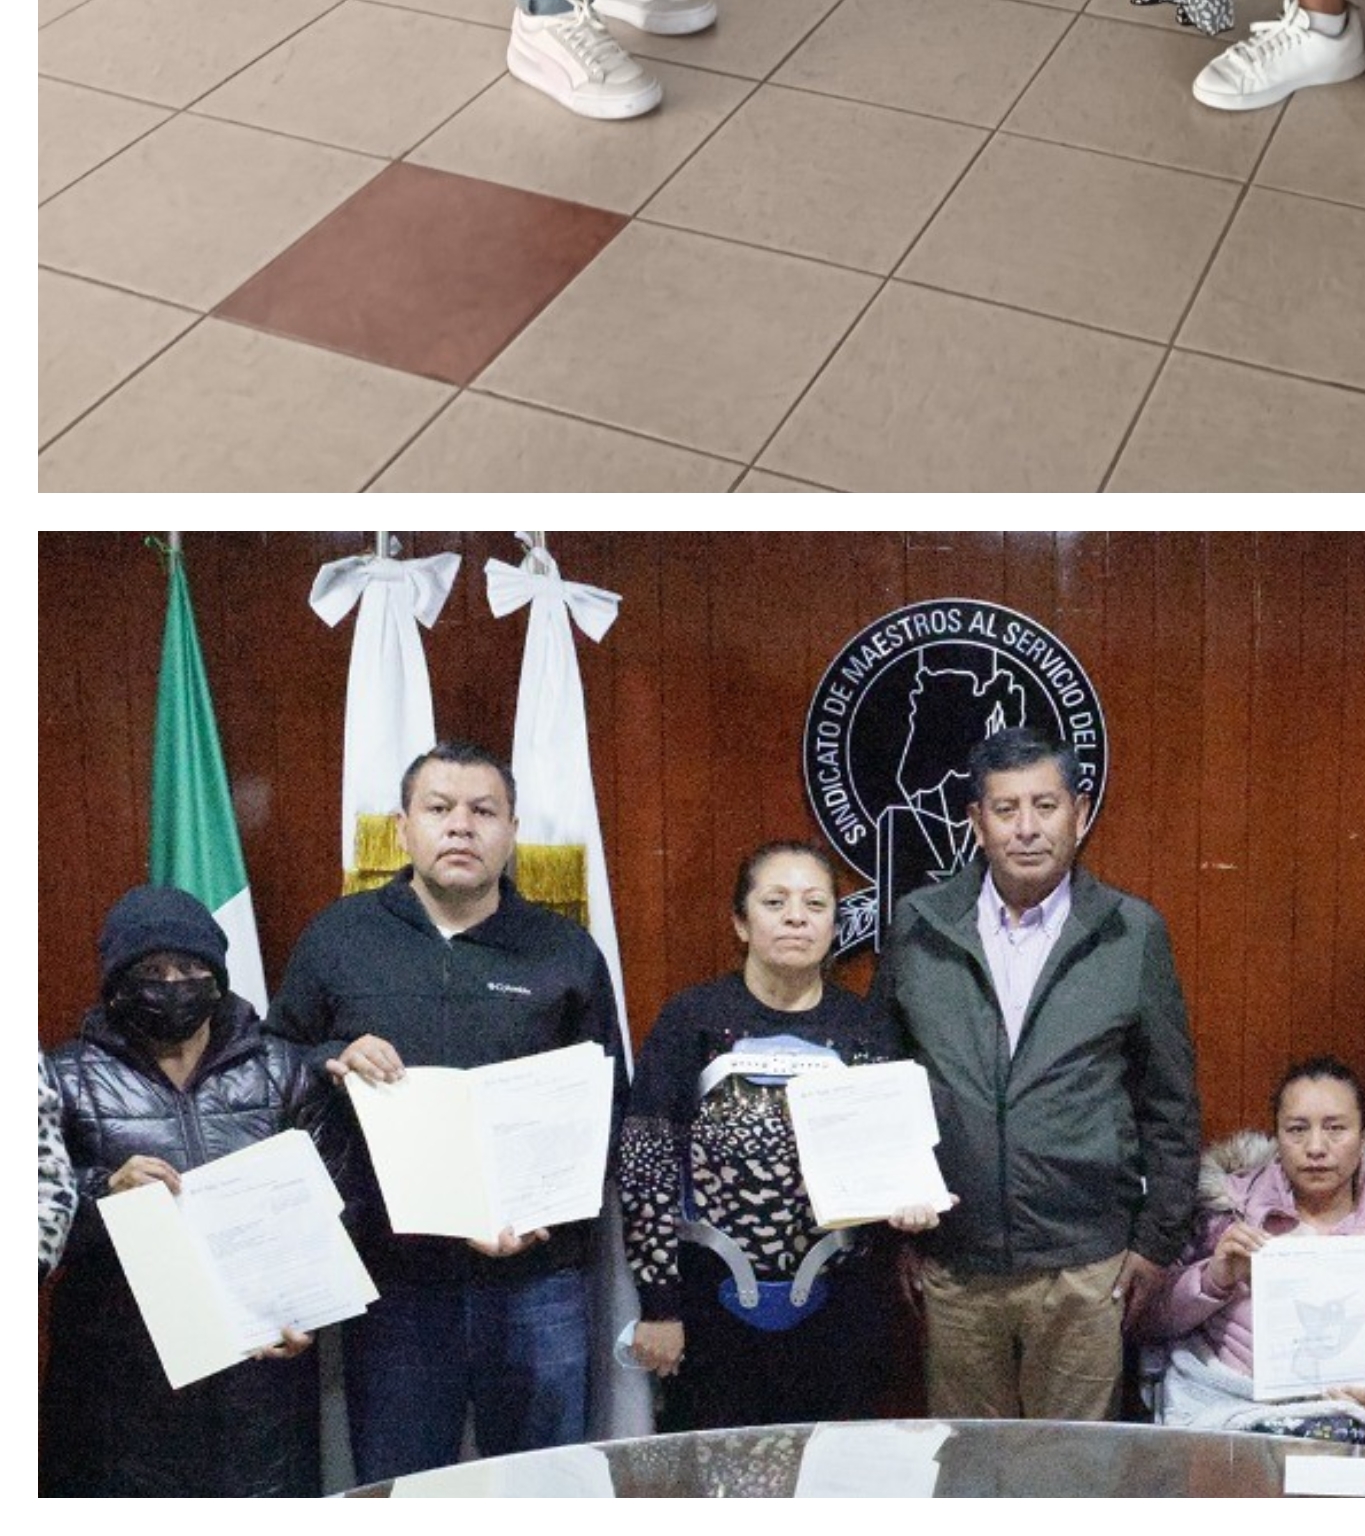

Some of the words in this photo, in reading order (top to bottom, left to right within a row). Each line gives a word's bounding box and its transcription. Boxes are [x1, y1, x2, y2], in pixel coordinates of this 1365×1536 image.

[842, 608, 962, 685] MAESTROS
[968, 610, 998, 639] AL
[824, 685, 848, 717] DE
[1002, 621, 1085, 708] SERVICIO
[816, 723, 867, 845] SINDICATO
